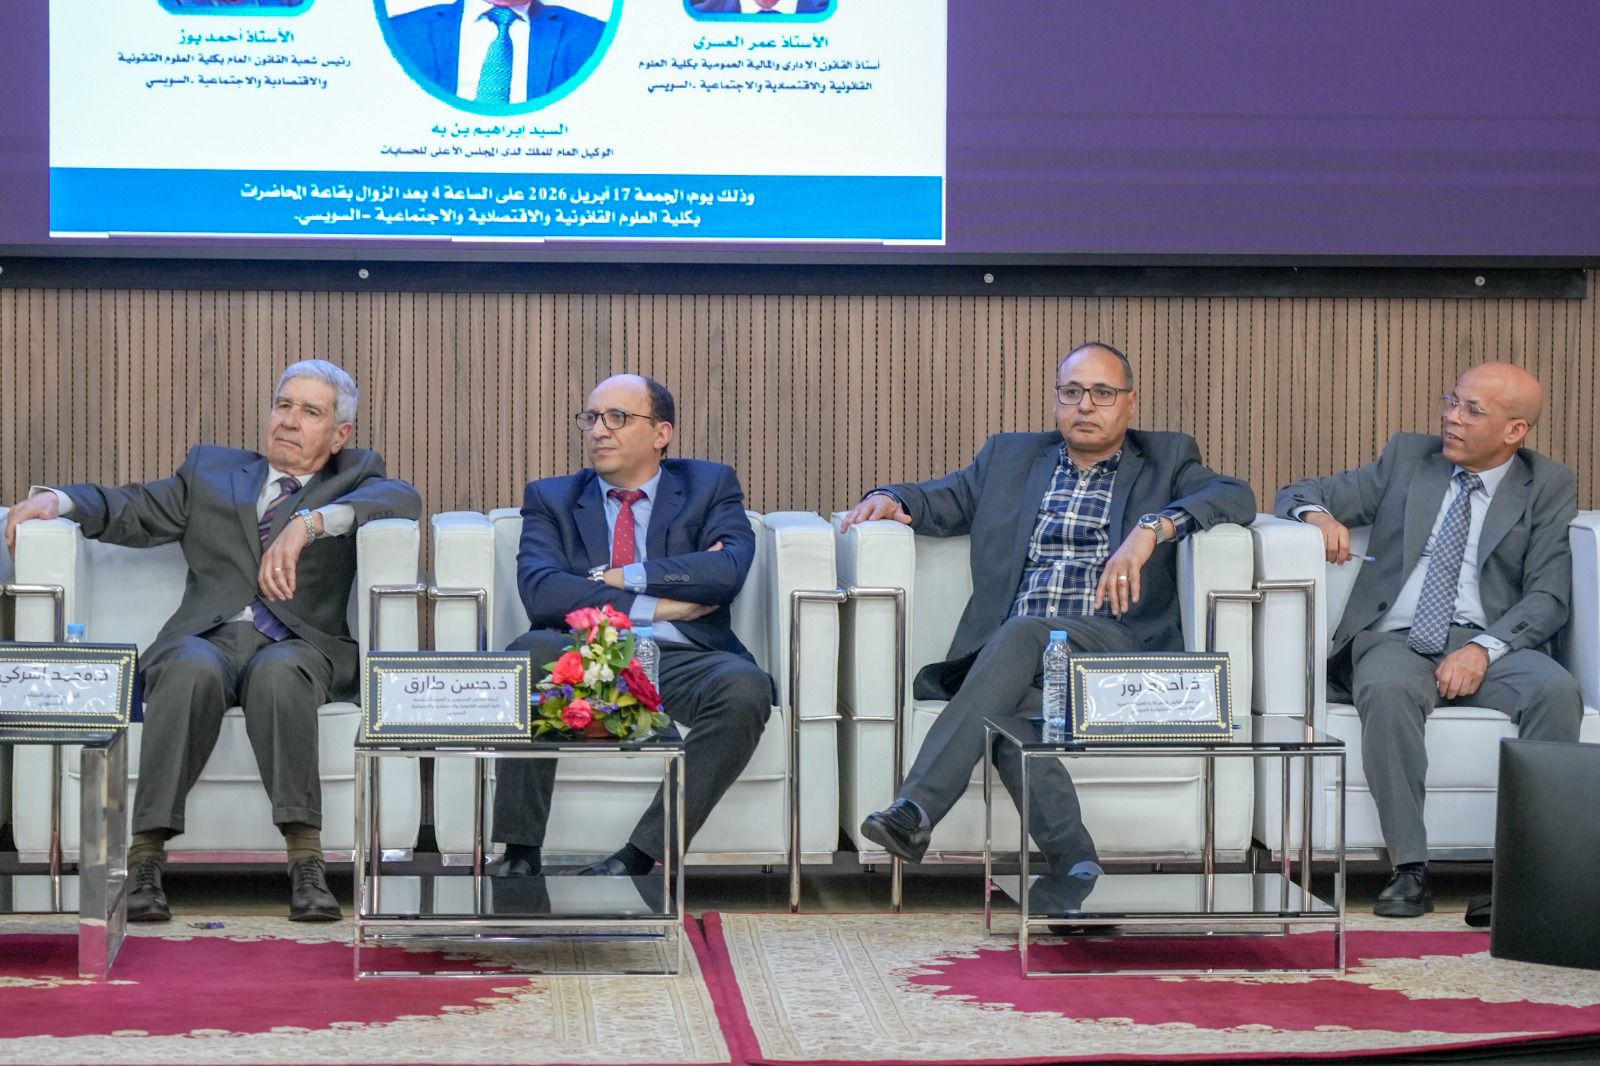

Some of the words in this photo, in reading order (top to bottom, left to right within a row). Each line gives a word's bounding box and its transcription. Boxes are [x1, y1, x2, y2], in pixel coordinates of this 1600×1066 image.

[310, 184, 353, 203] بقاعة
[356, 185, 399, 203] الزوال
[403, 186, 428, 202] بعد
[432, 187, 439, 200] 4
[444, 185, 493, 201] الساعة
[495, 187, 524, 205] على
[529, 187, 567, 202] 2026
[613, 187, 631, 202] 17
[635, 187, 683, 206] الجمعة
[717, 188, 755, 206] وذلك
[375, 207, 463, 225] والاجتماعية
[469, 209, 550, 226] والاقتصادية
[555, 209, 615, 226] القانونية
[619, 209, 658, 226] العلوم
[662, 209, 701, 228] بكلية
